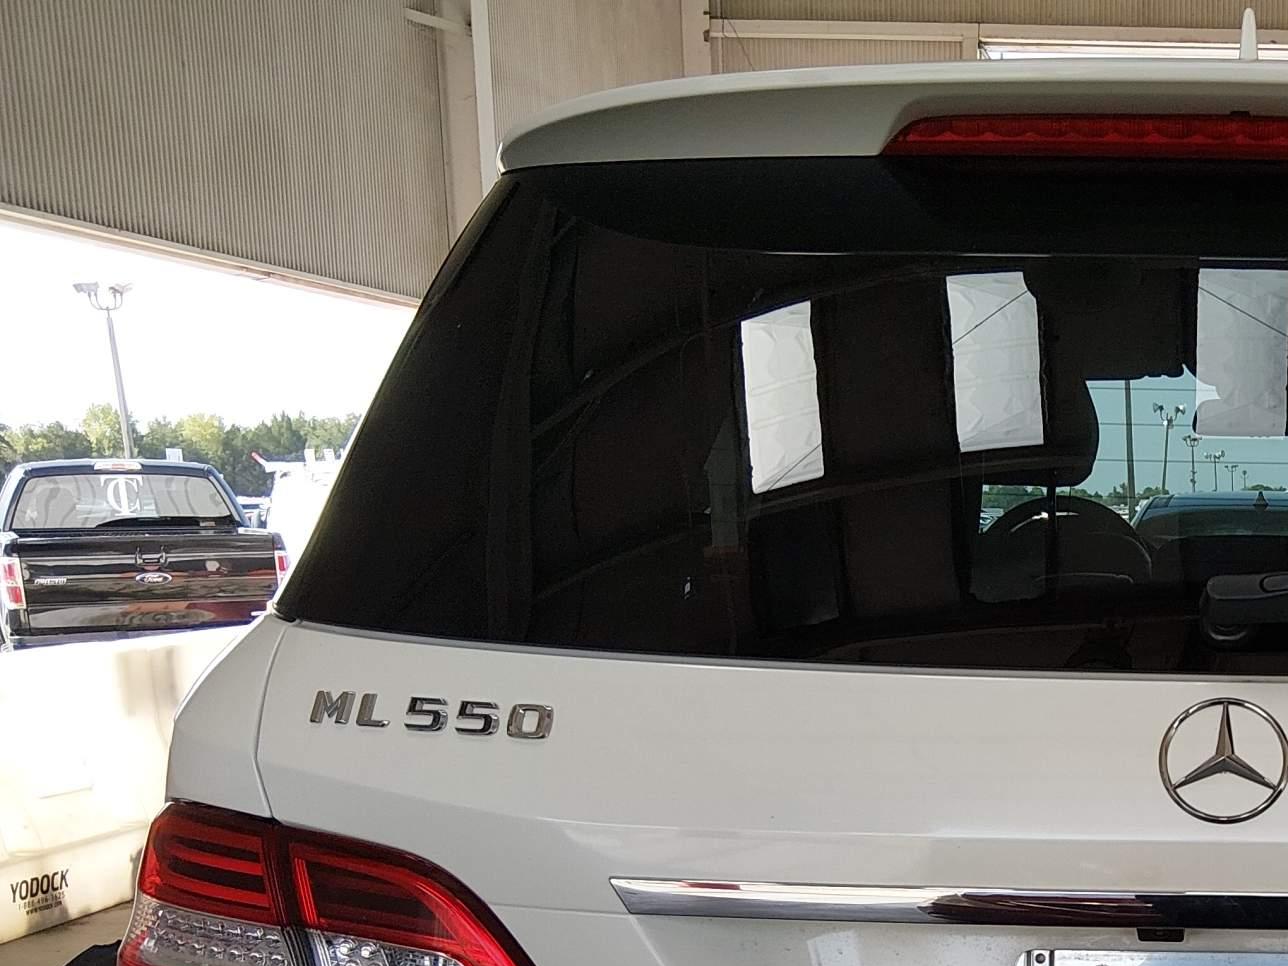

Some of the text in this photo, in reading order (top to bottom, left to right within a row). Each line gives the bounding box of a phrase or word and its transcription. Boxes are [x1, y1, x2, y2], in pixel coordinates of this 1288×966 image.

[310, 690, 554, 739] ML 550
[10, 868, 69, 903] YODOCK
